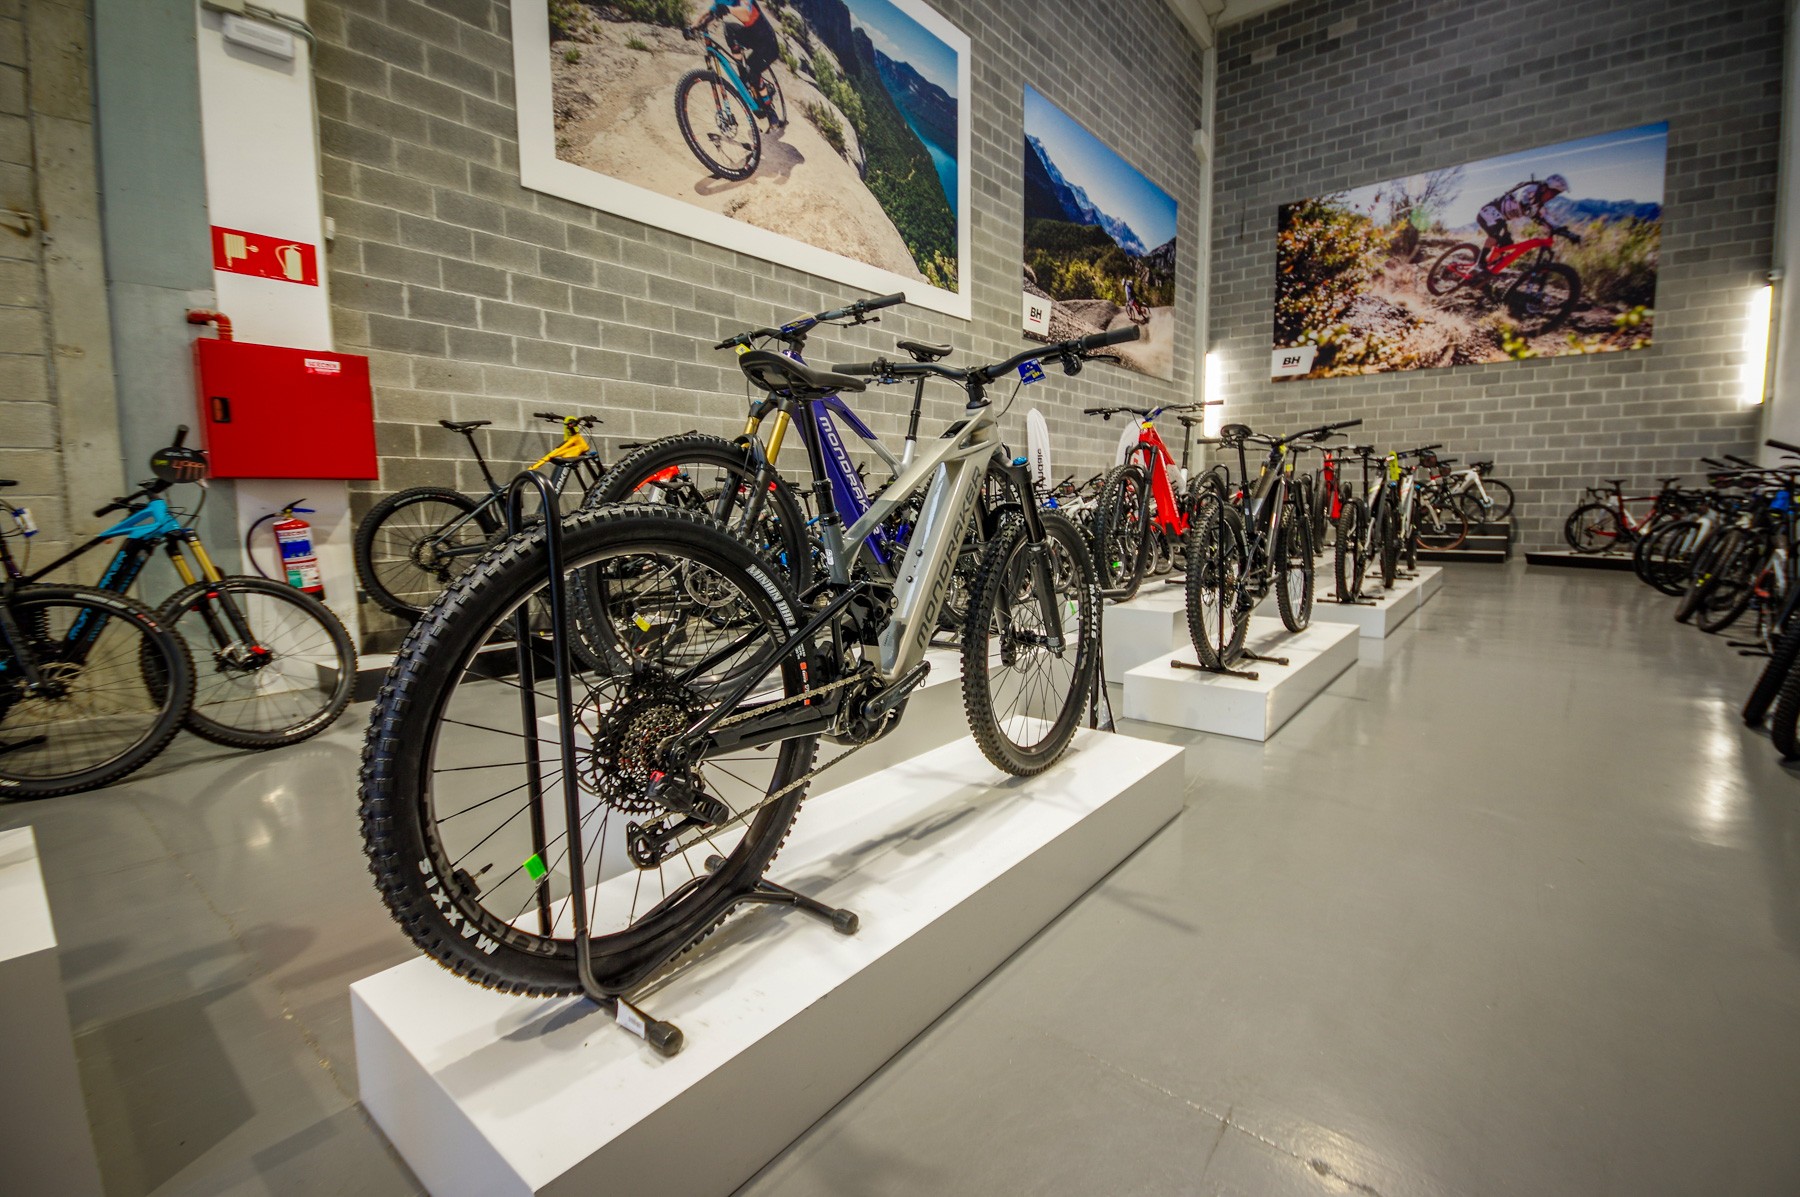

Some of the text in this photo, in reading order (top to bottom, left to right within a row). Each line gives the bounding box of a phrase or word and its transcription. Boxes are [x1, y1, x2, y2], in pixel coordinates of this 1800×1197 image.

[1030, 306, 1043, 320] BH
[1282, 355, 1301, 366] BH
[916, 465, 983, 650] MONDRAKER
[745, 563, 784, 603] MINION
[1088, 583, 1098, 640] MAXXIS
[418, 857, 500, 956] MAXXIS
